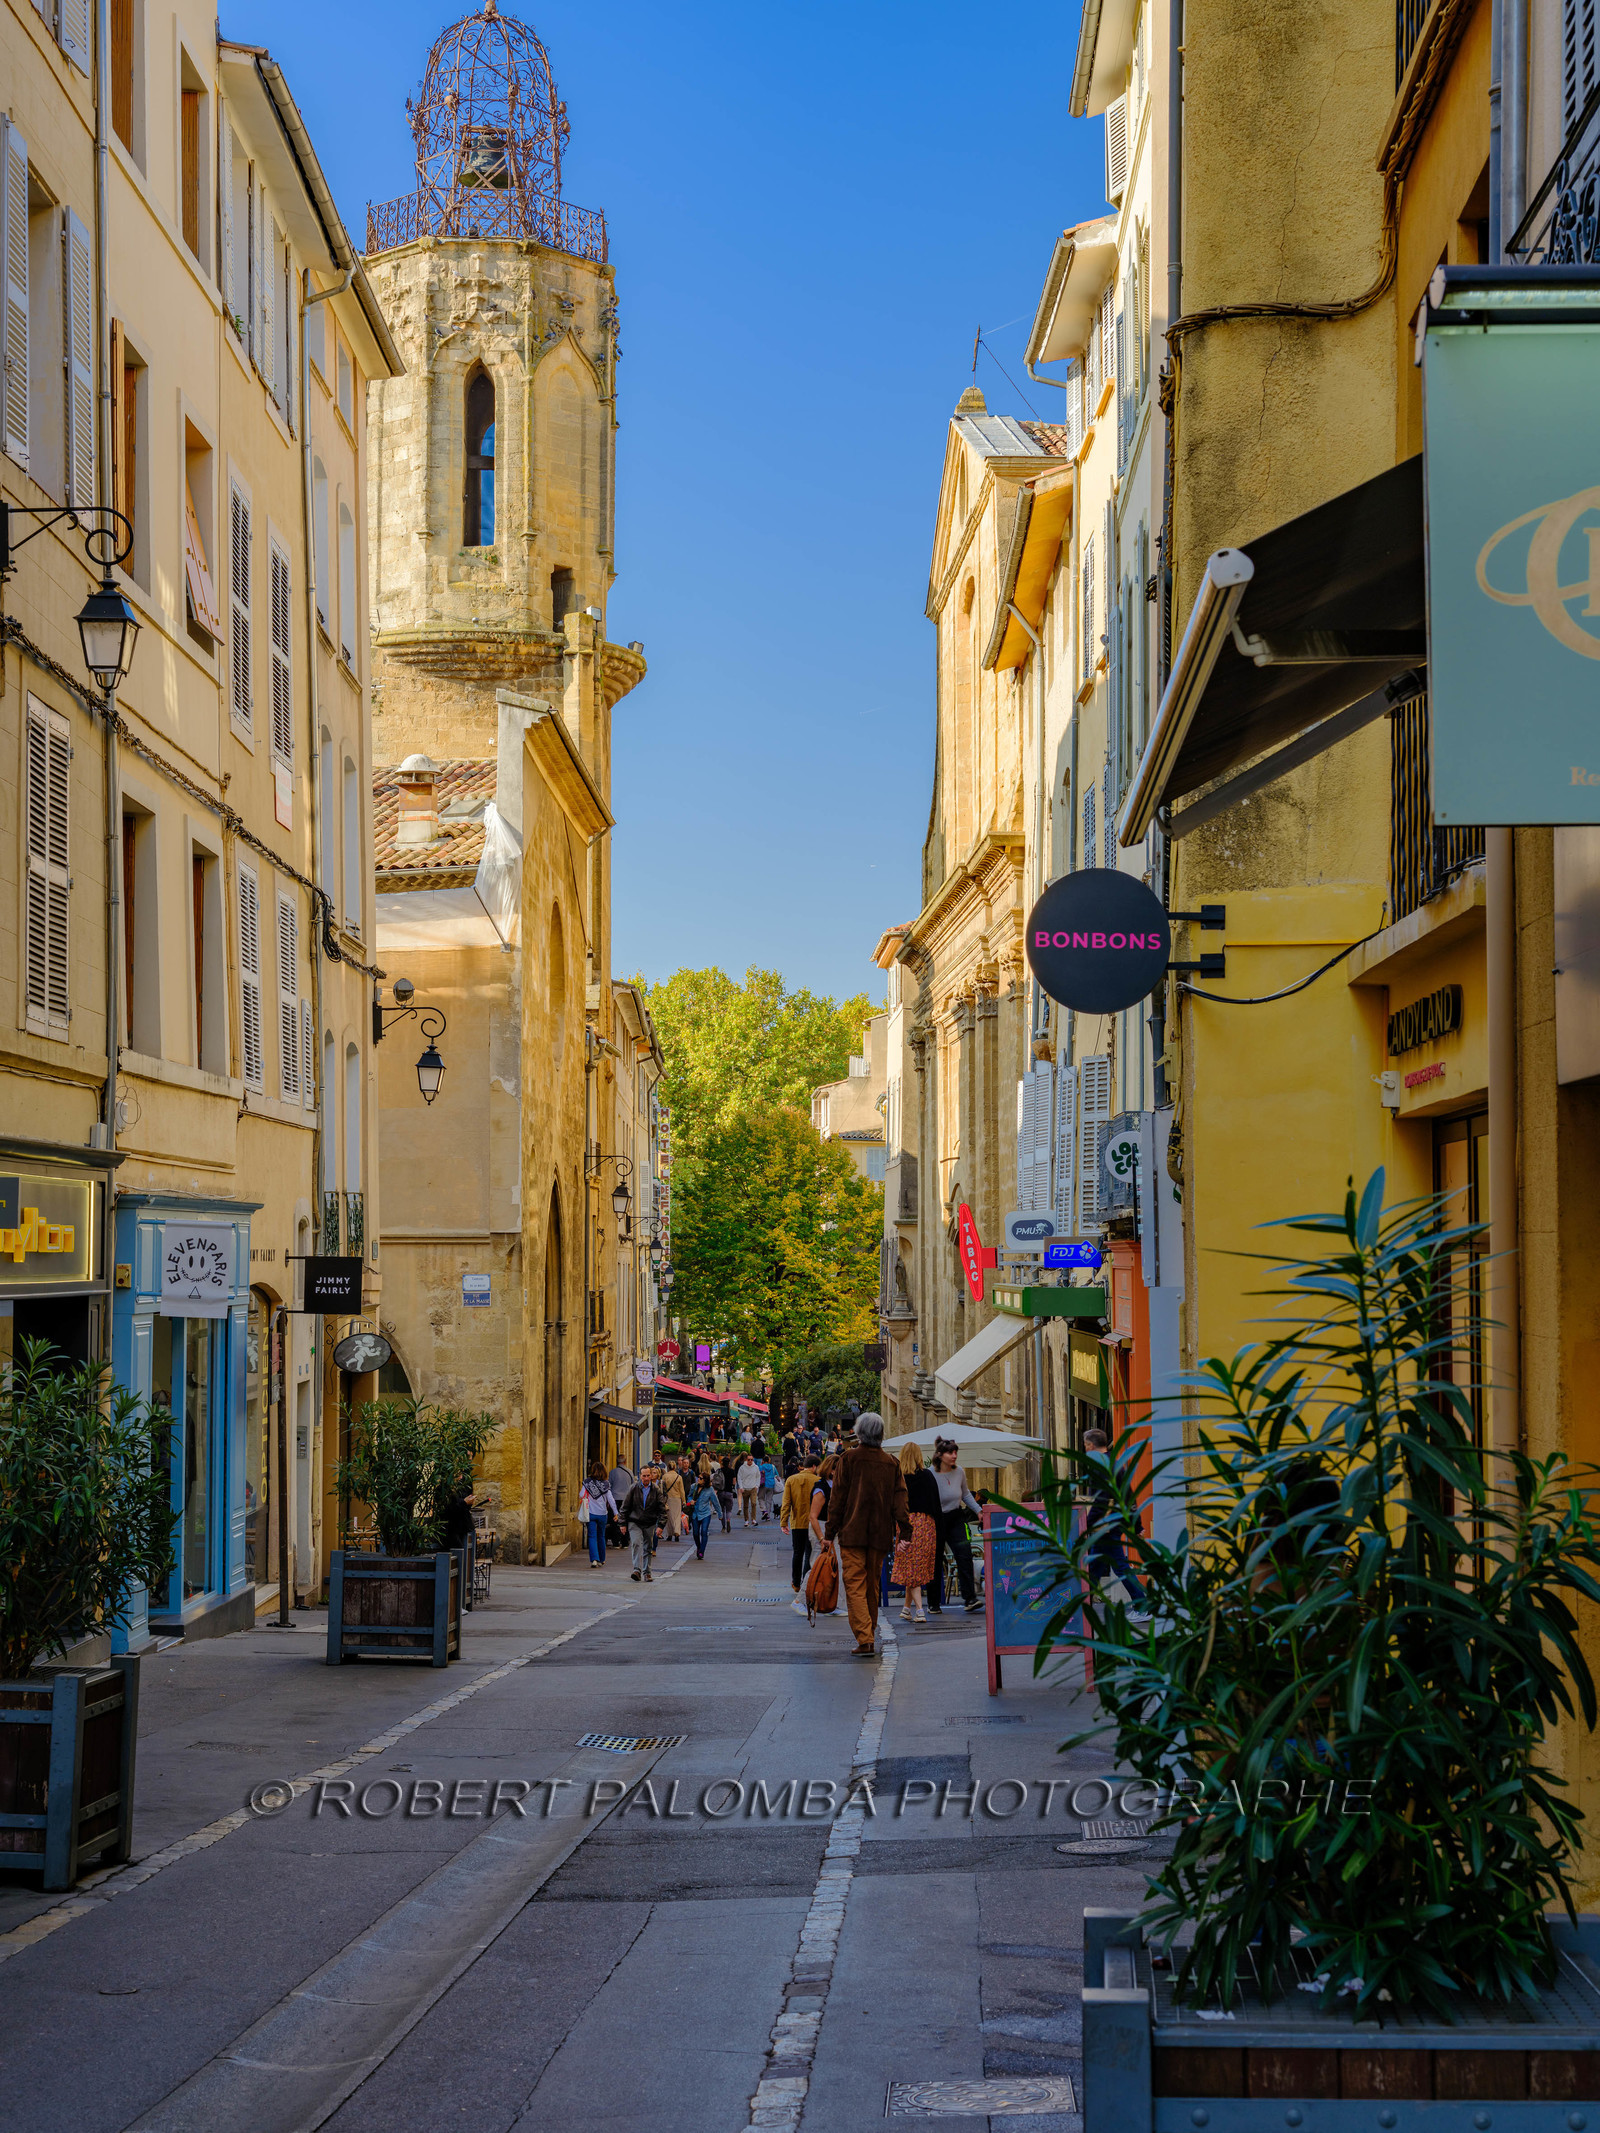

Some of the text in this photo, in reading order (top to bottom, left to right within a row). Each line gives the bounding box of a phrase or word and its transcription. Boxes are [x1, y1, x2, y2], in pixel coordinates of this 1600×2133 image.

[1035, 931, 1161, 950] BONBONS
[1387, 984, 1462, 1056] CANDYLAND
[660, 1108, 670, 1180] HOTEL
[1015, 1227, 1036, 1236] PMU
[166, 1238, 227, 1287] ELEVENPARIS
[963, 1222, 979, 1282] TABAC
[1052, 1247, 1075, 1257] FDJ
[315, 1286, 351, 1294] FAIRLY
[316, 1277, 351, 1285] JIMMY
[260, 1326, 269, 1504] OPTICIEN
